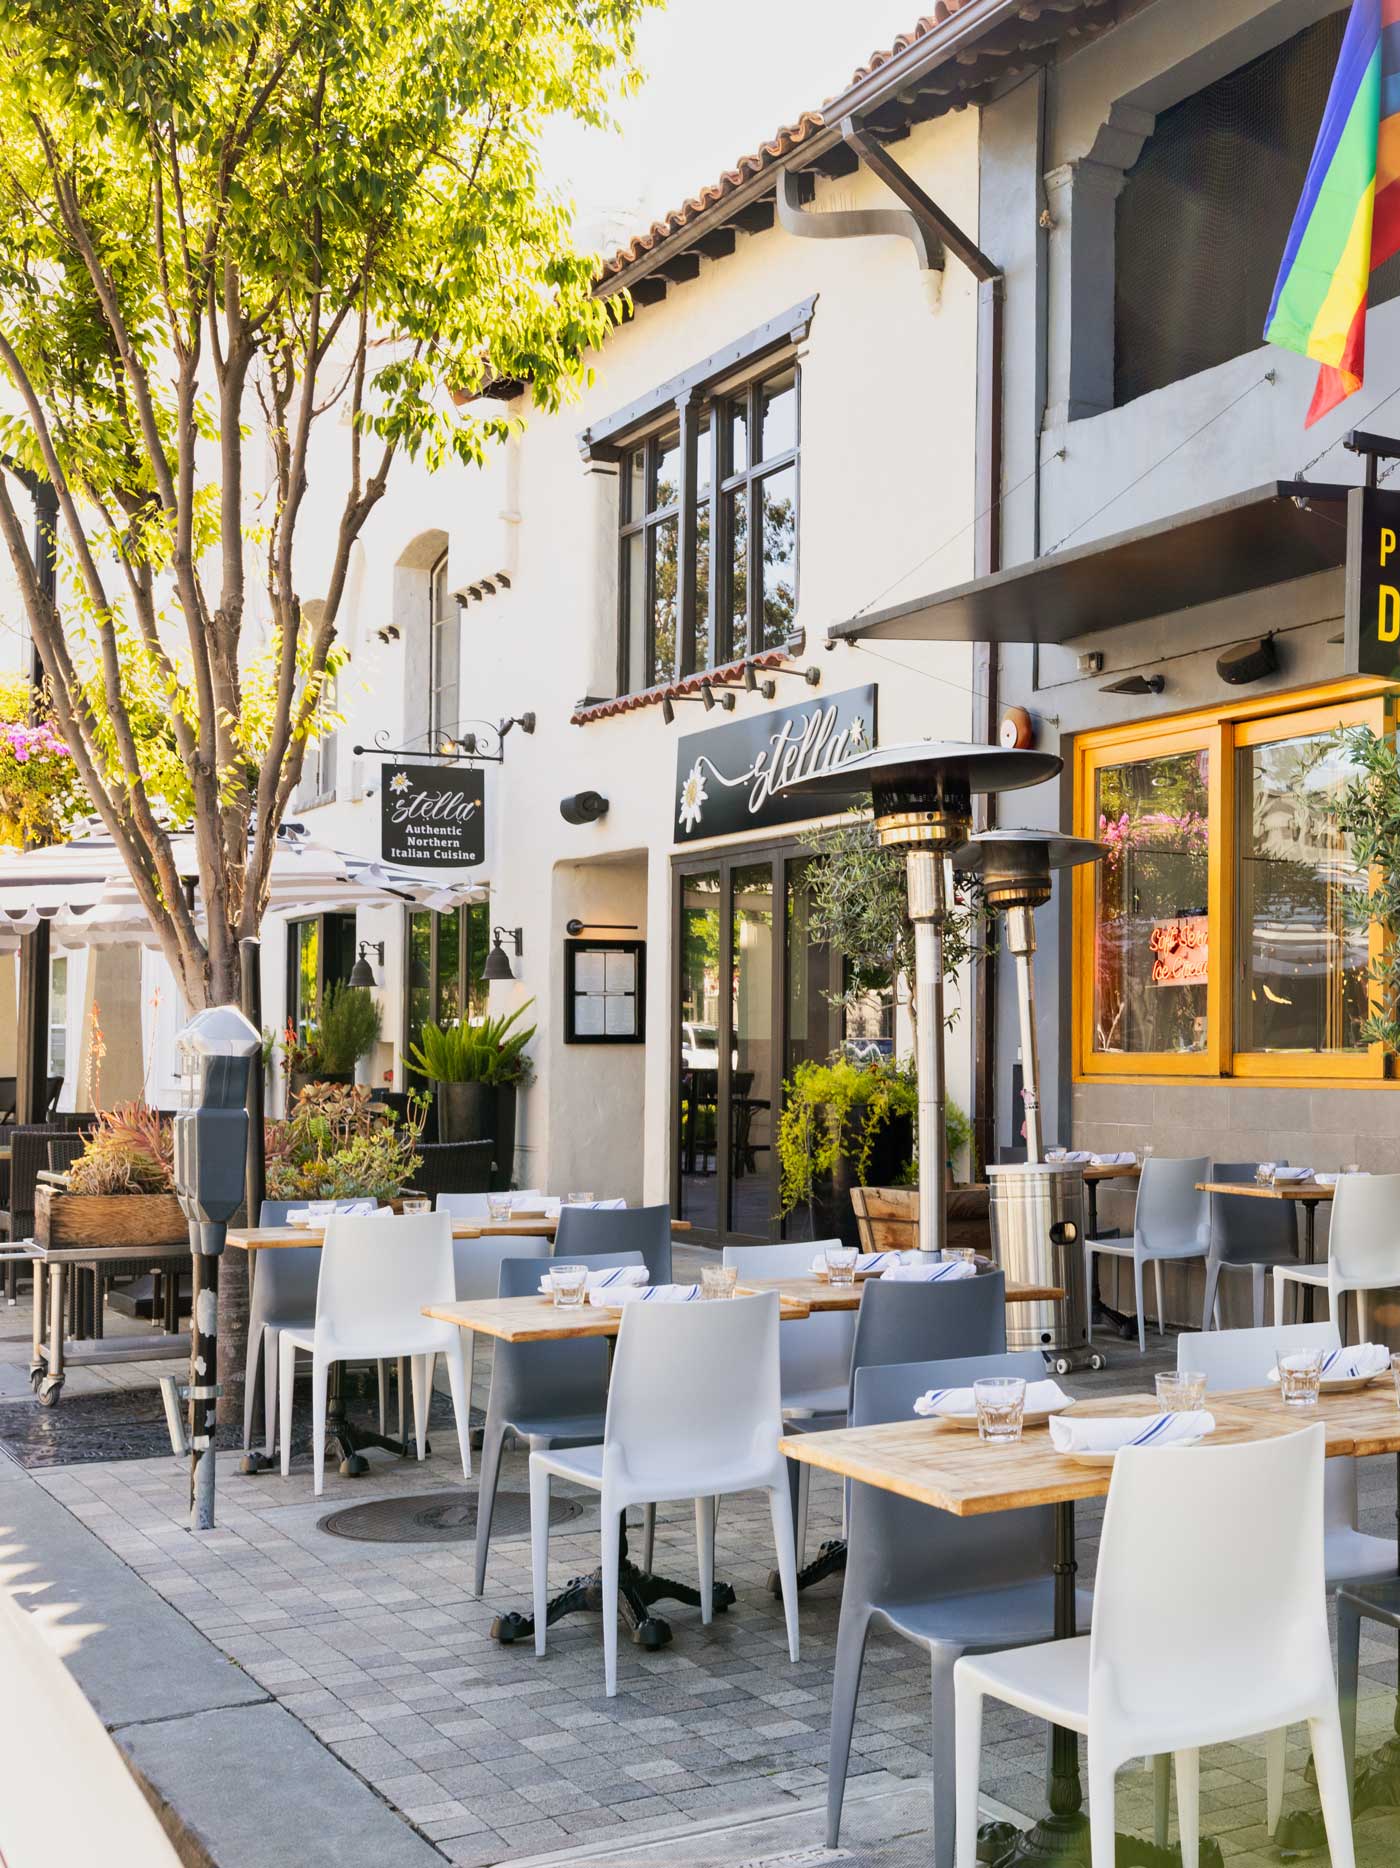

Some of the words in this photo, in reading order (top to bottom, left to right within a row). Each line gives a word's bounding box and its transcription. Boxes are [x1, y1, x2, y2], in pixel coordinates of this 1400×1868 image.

[405, 824, 463, 836] Authentic
[407, 836, 460, 848] Northern
[391, 848, 431, 859] Italian
[434, 849, 476, 860] Cuisine
[1149, 925, 1178, 956] Soft
[1179, 925, 1208, 948] Serv
[1152, 959, 1171, 981] Ice
[1172, 957, 1208, 978] Crea
